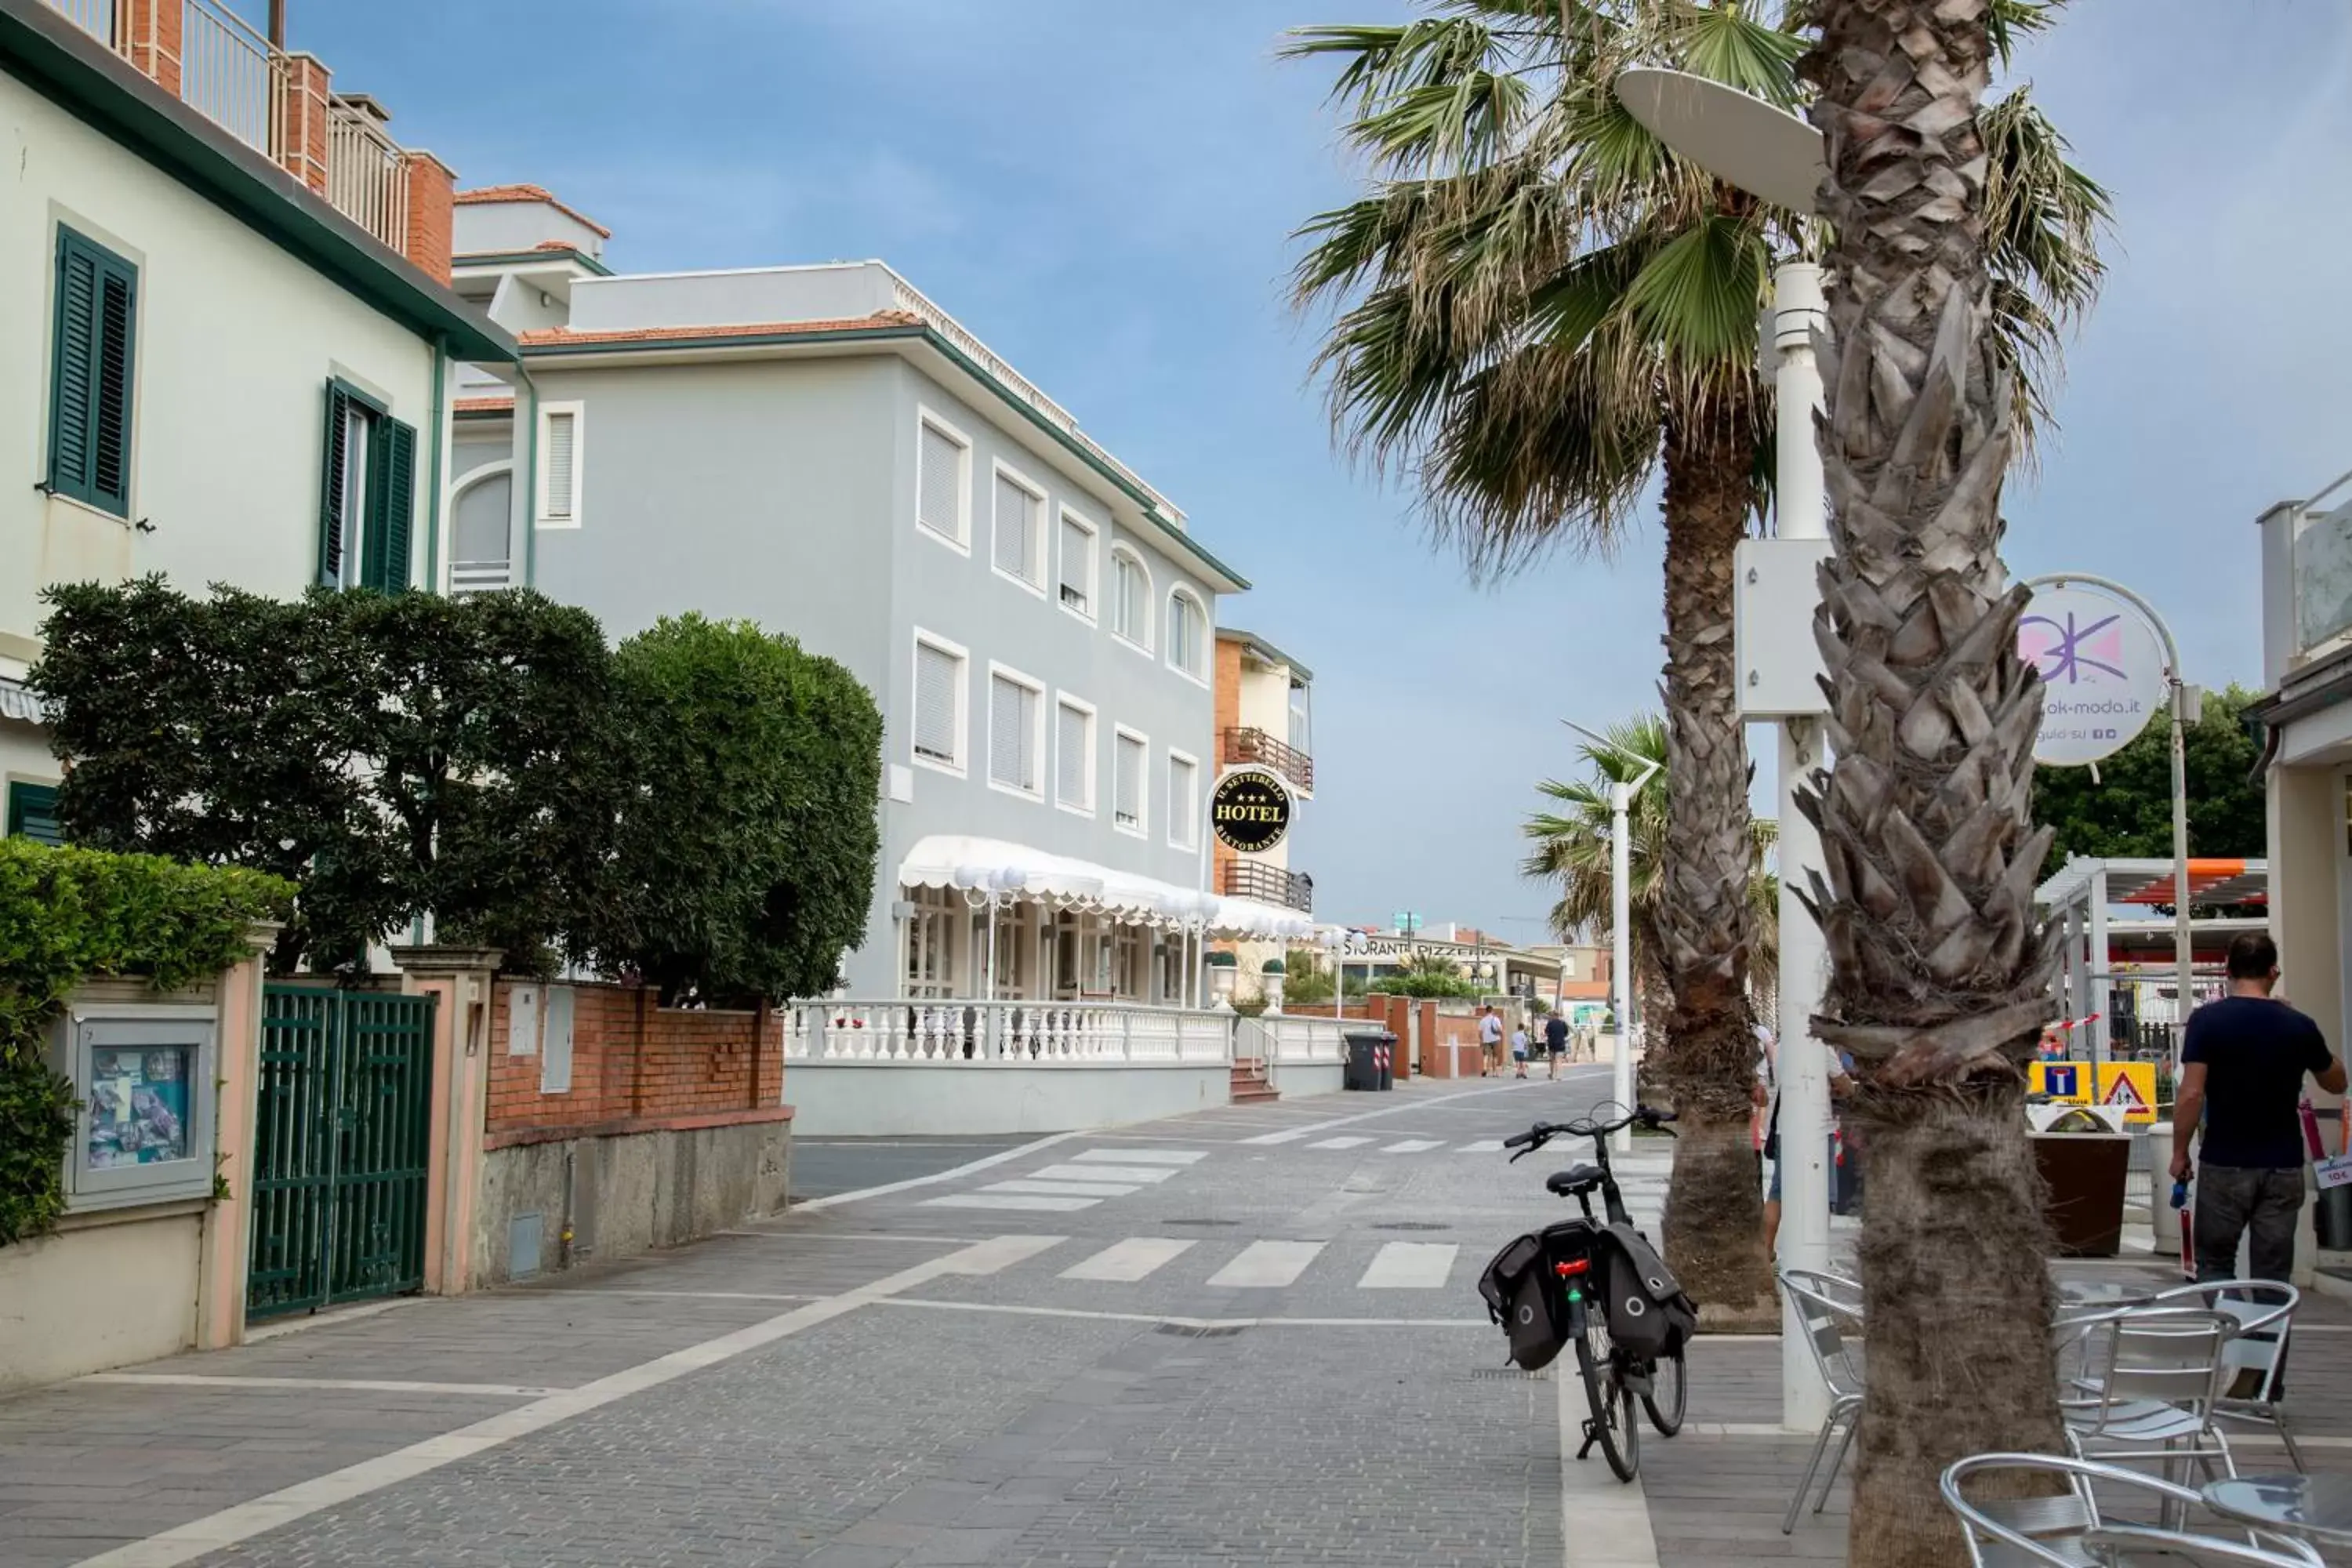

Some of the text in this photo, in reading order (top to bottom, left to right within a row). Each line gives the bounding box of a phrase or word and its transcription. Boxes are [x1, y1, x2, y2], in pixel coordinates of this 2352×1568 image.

[1217, 789, 1228, 800] IL
[1216, 804, 1285, 822] HOTEL
[1216, 824, 1283, 851] RISTORANTE
[1417, 945, 1497, 956] PIZZERIA
